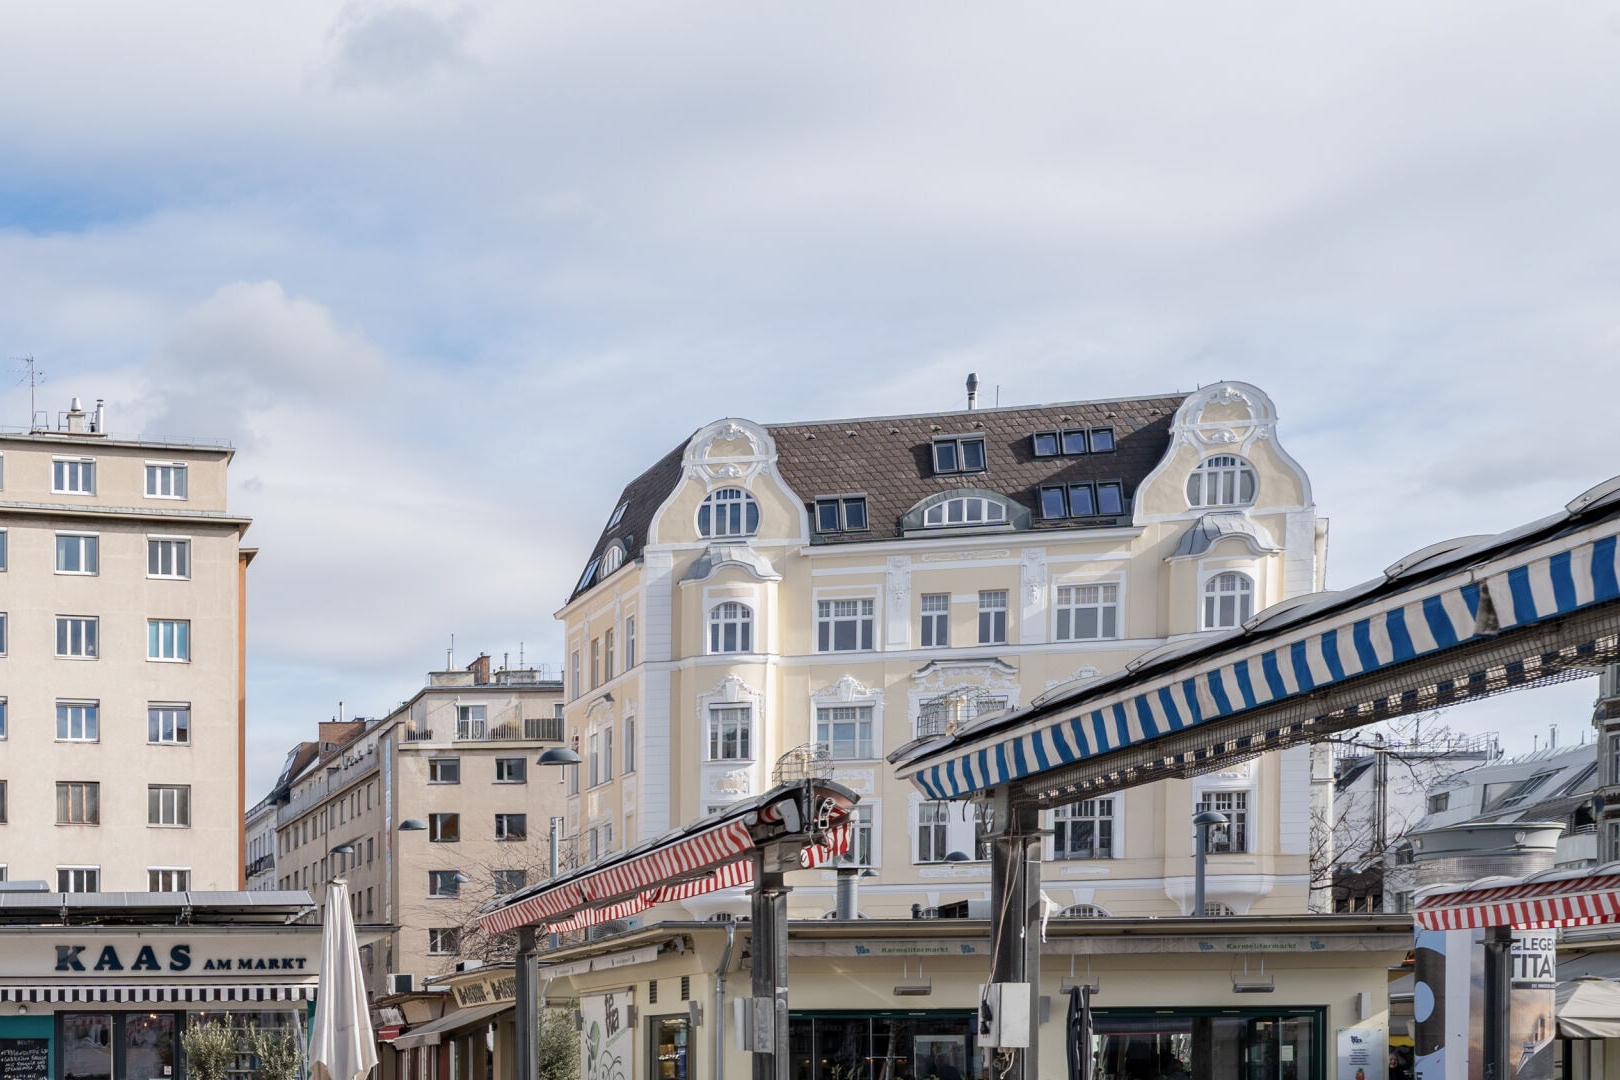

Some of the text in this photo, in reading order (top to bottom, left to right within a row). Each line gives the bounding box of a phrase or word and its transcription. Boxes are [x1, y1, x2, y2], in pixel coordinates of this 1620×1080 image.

[54, 944, 307, 971] KAAS AM MARKT
